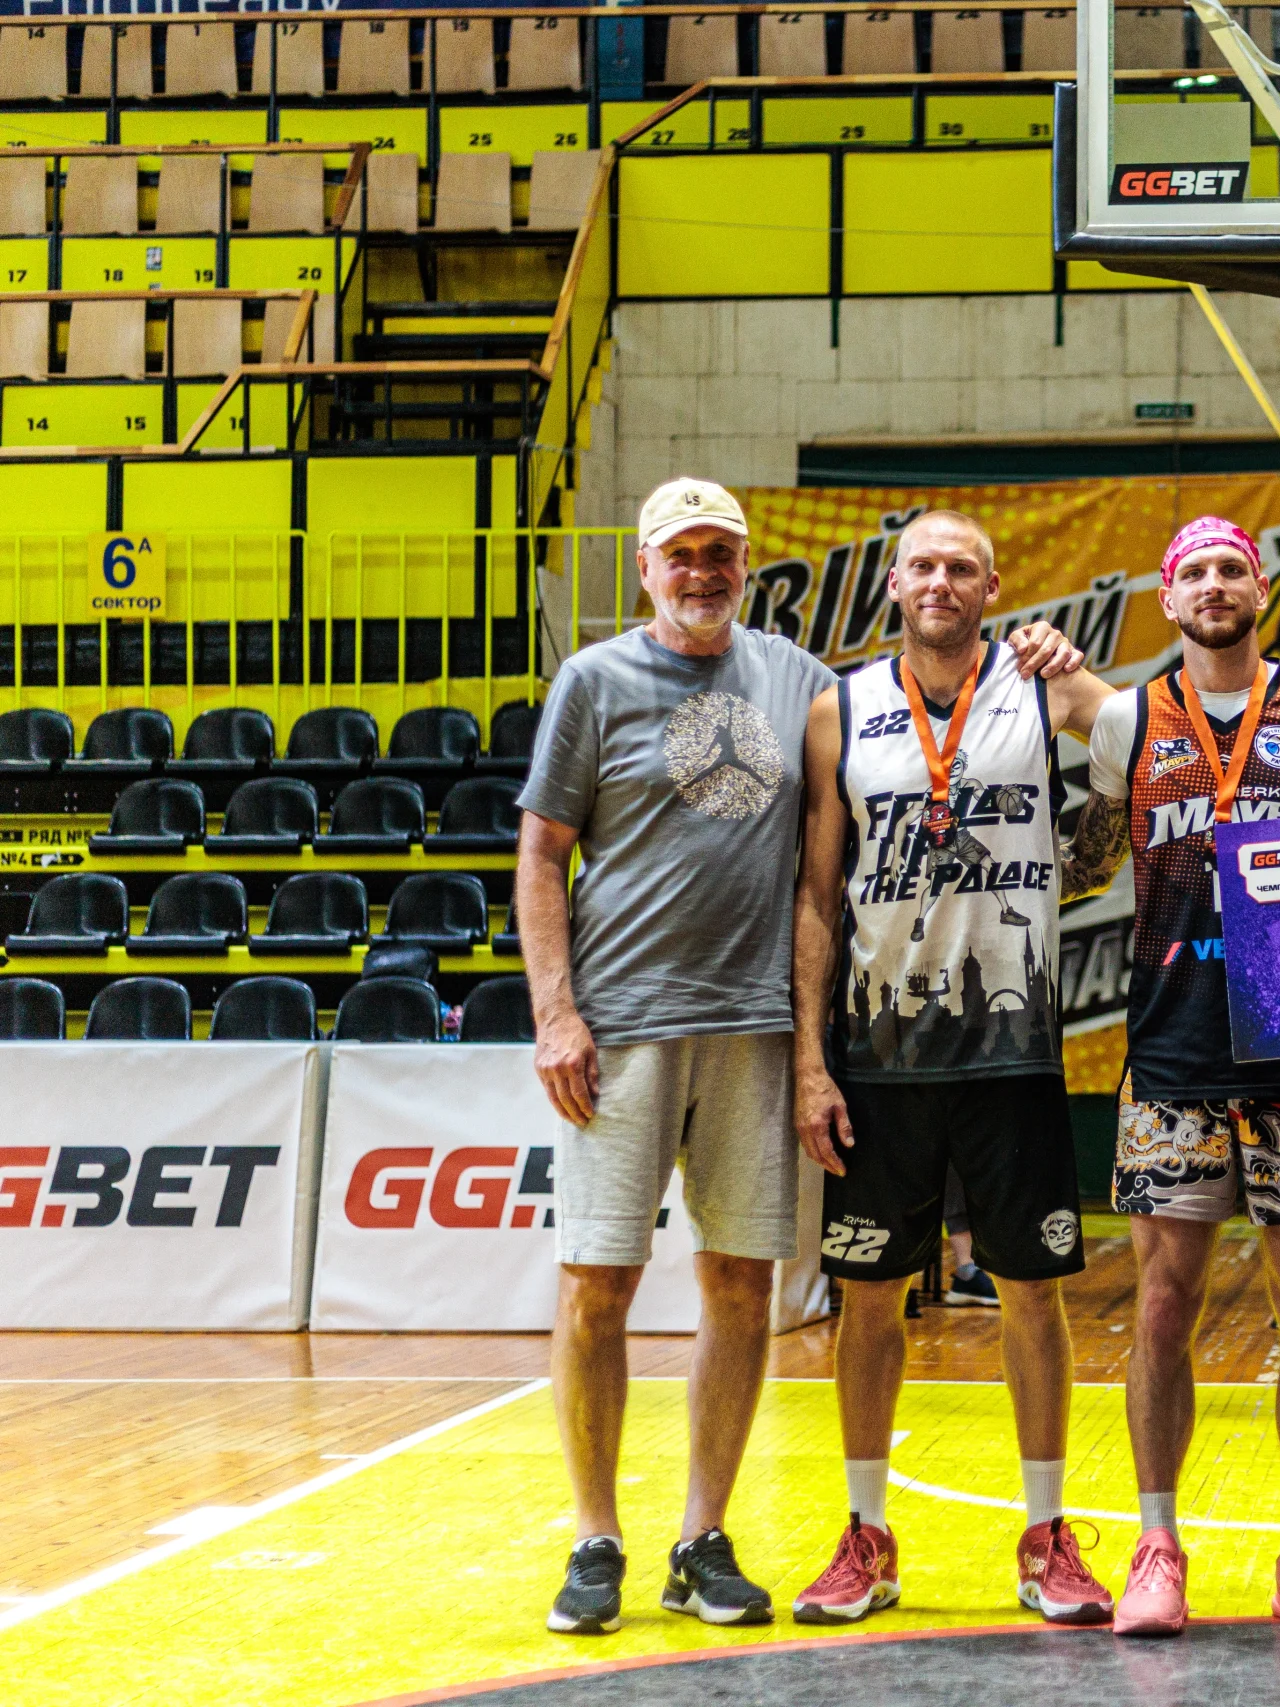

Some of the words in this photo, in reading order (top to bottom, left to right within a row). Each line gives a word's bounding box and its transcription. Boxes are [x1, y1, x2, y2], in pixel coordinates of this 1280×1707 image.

[27, 27, 46, 39] 14
[373, 137, 396, 149] 24
[469, 133, 493, 146] 25
[651, 130, 676, 145] 27
[840, 125, 865, 139] 29
[8, 270, 28, 282] 17
[103, 269, 124, 282] 18
[195, 269, 214, 282] 19
[297, 267, 322, 280] 20
[27, 417, 49, 431] 14
[125, 416, 146, 430] 15
[92, 595, 162, 612] сектор
[859, 709, 912, 740] 22
[30, 830, 62, 845] РЯД
[859, 870, 919, 904] THE
[929, 860, 1054, 898] PALACE
[842, 1214, 876, 1227] PRISMA
[820, 1221, 891, 1263] 22
